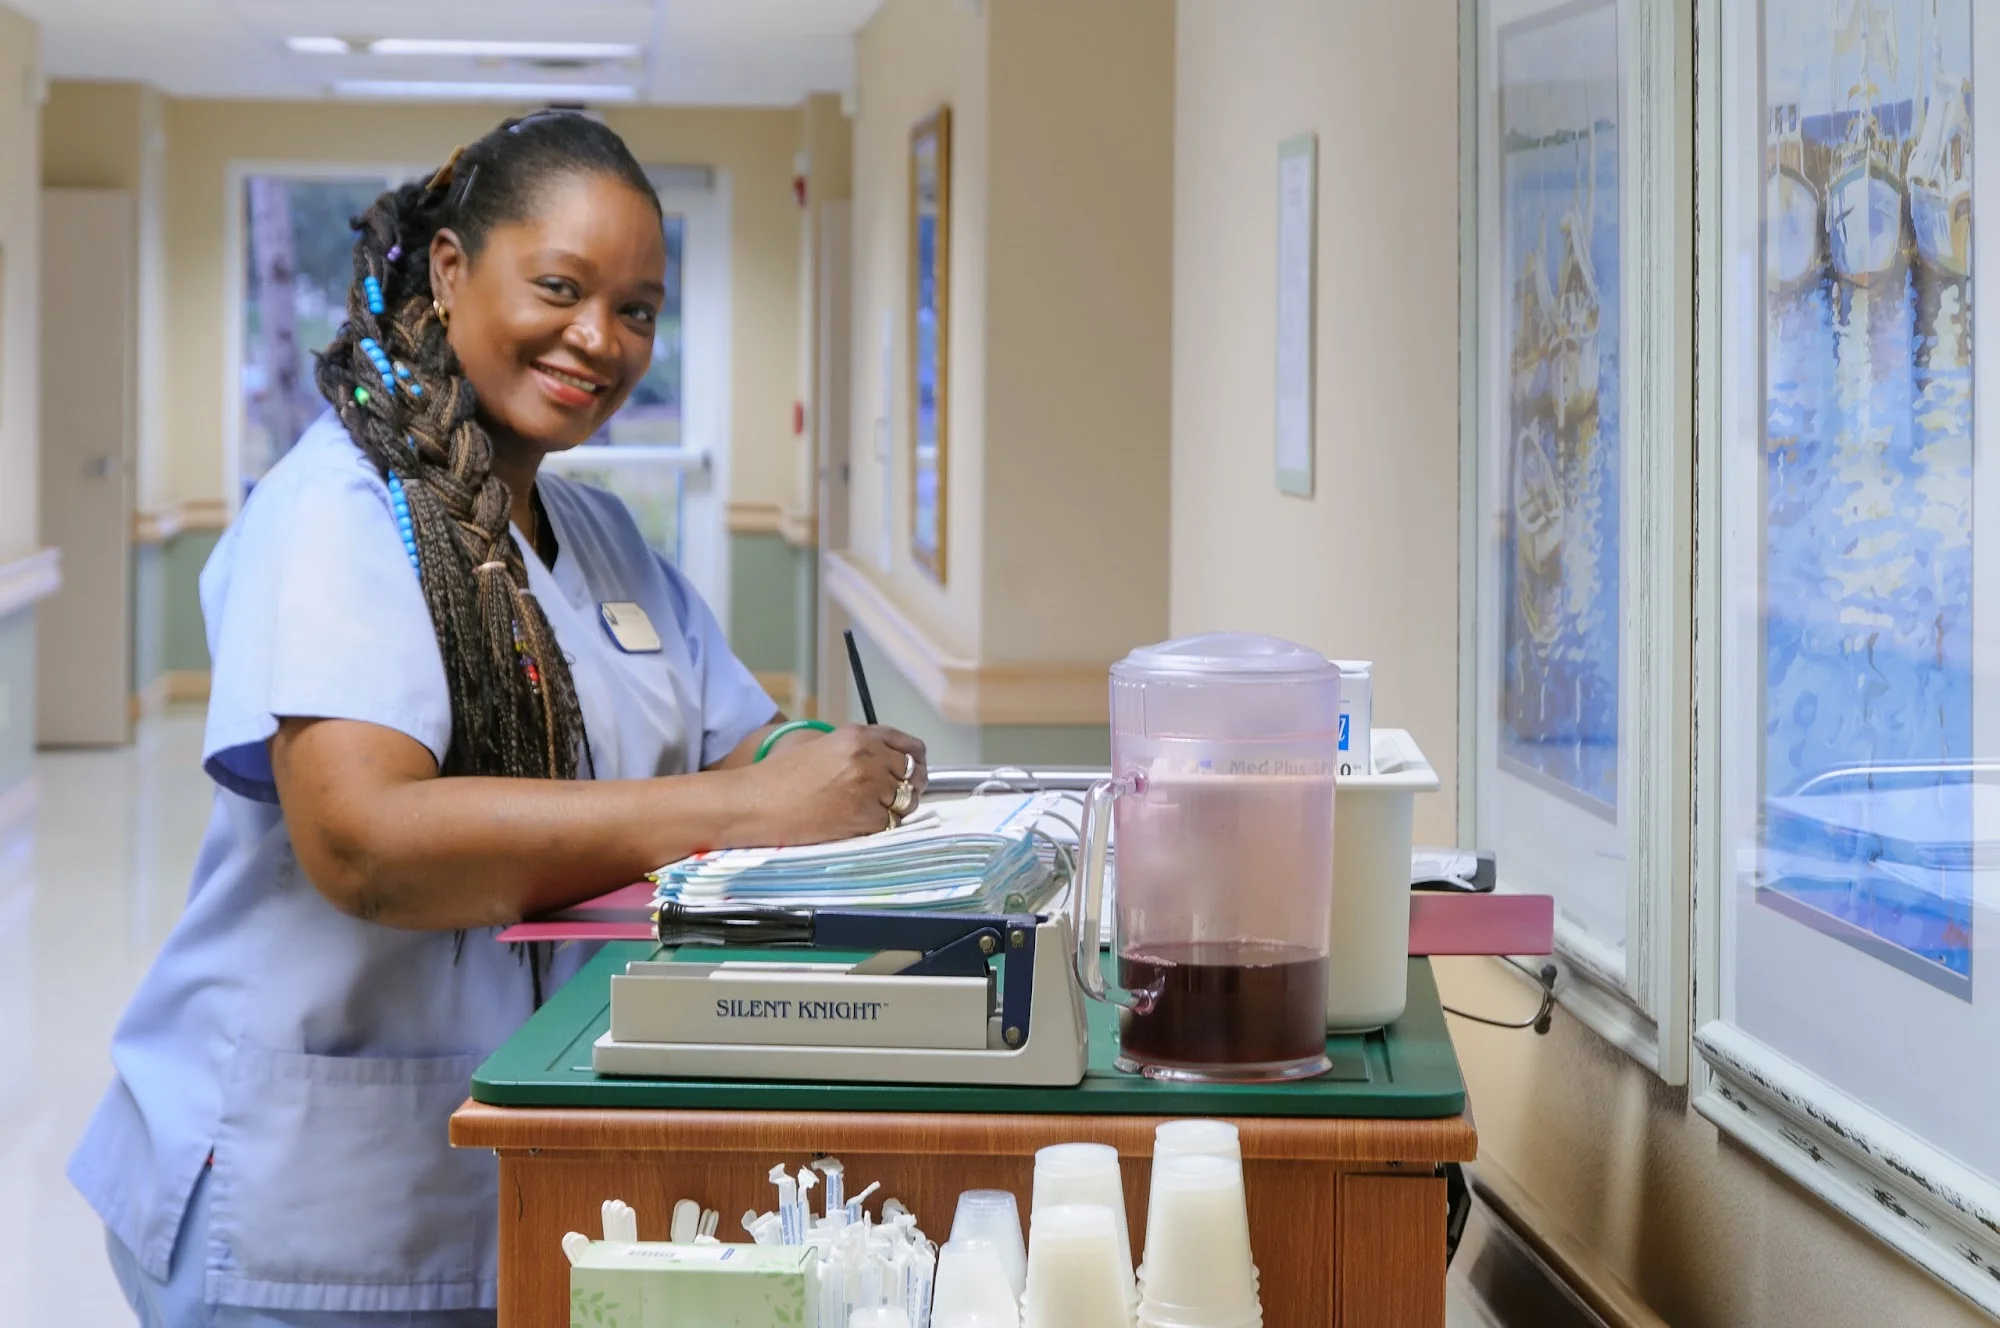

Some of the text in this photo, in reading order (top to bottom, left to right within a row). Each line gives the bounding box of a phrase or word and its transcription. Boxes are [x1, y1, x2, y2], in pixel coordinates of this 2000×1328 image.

[1229, 760, 1269, 775] Med
[1273, 760, 1306, 775] Plus
[716, 999, 882, 1021] SILENT KNIGHT
